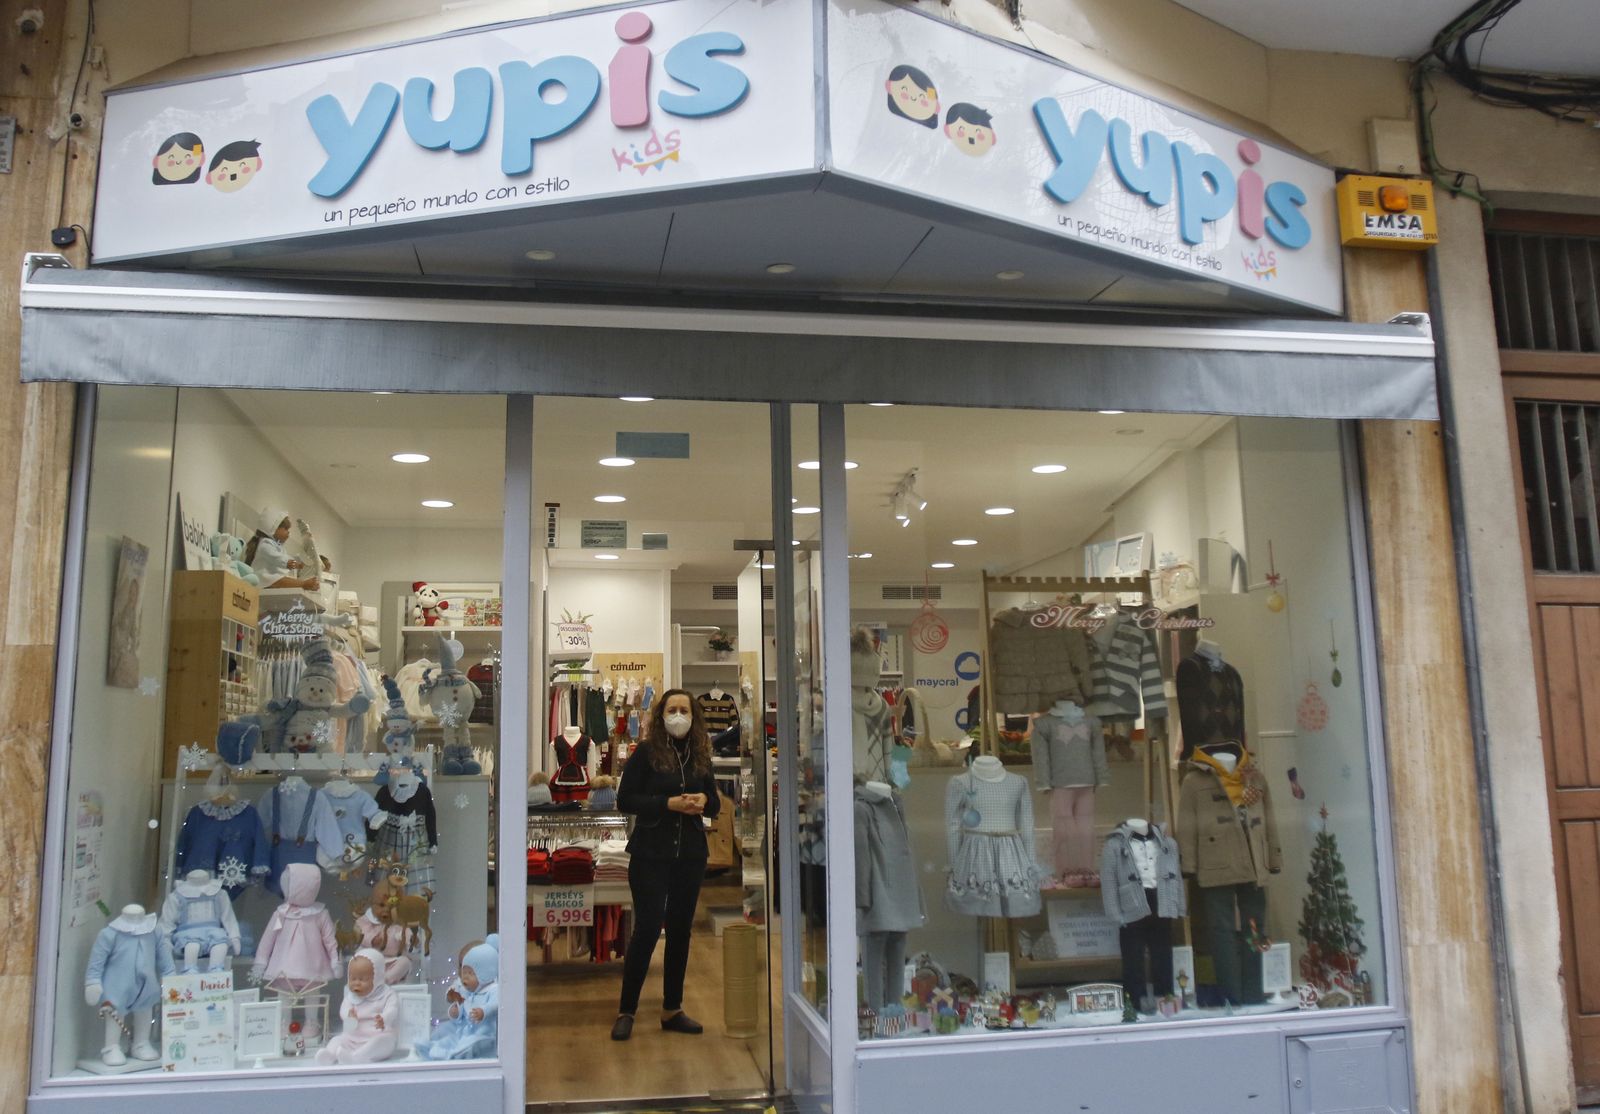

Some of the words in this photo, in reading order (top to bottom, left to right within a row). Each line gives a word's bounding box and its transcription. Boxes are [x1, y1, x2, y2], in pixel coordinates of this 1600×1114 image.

[306, 11, 750, 197] yupis
[612, 127, 681, 172] kids
[1033, 97, 1312, 249] yupis
[324, 208, 342, 223] un
[348, 197, 416, 226] pequeño
[423, 189, 478, 209] mundo
[485, 185, 517, 201] con
[525, 176, 570, 196] estilo
[1365, 212, 1422, 230] EMSA
[1057, 214, 1073, 228] un
[1077, 220, 1126, 244] pequeño
[1131, 236, 1168, 255] mundo
[1172, 248, 1192, 261] con
[1196, 252, 1223, 271] estilo
[1242, 246, 1277, 271] kids
[262, 619, 324, 635] Christmas
[277, 611, 313, 625] Merry
[1030, 605, 1105, 634] Merry
[565, 636, 587, 646] -30%
[916, 677, 959, 688] mayoral
[546, 909, 591, 925] 6,99€
[200, 977, 231, 991] Daniel
